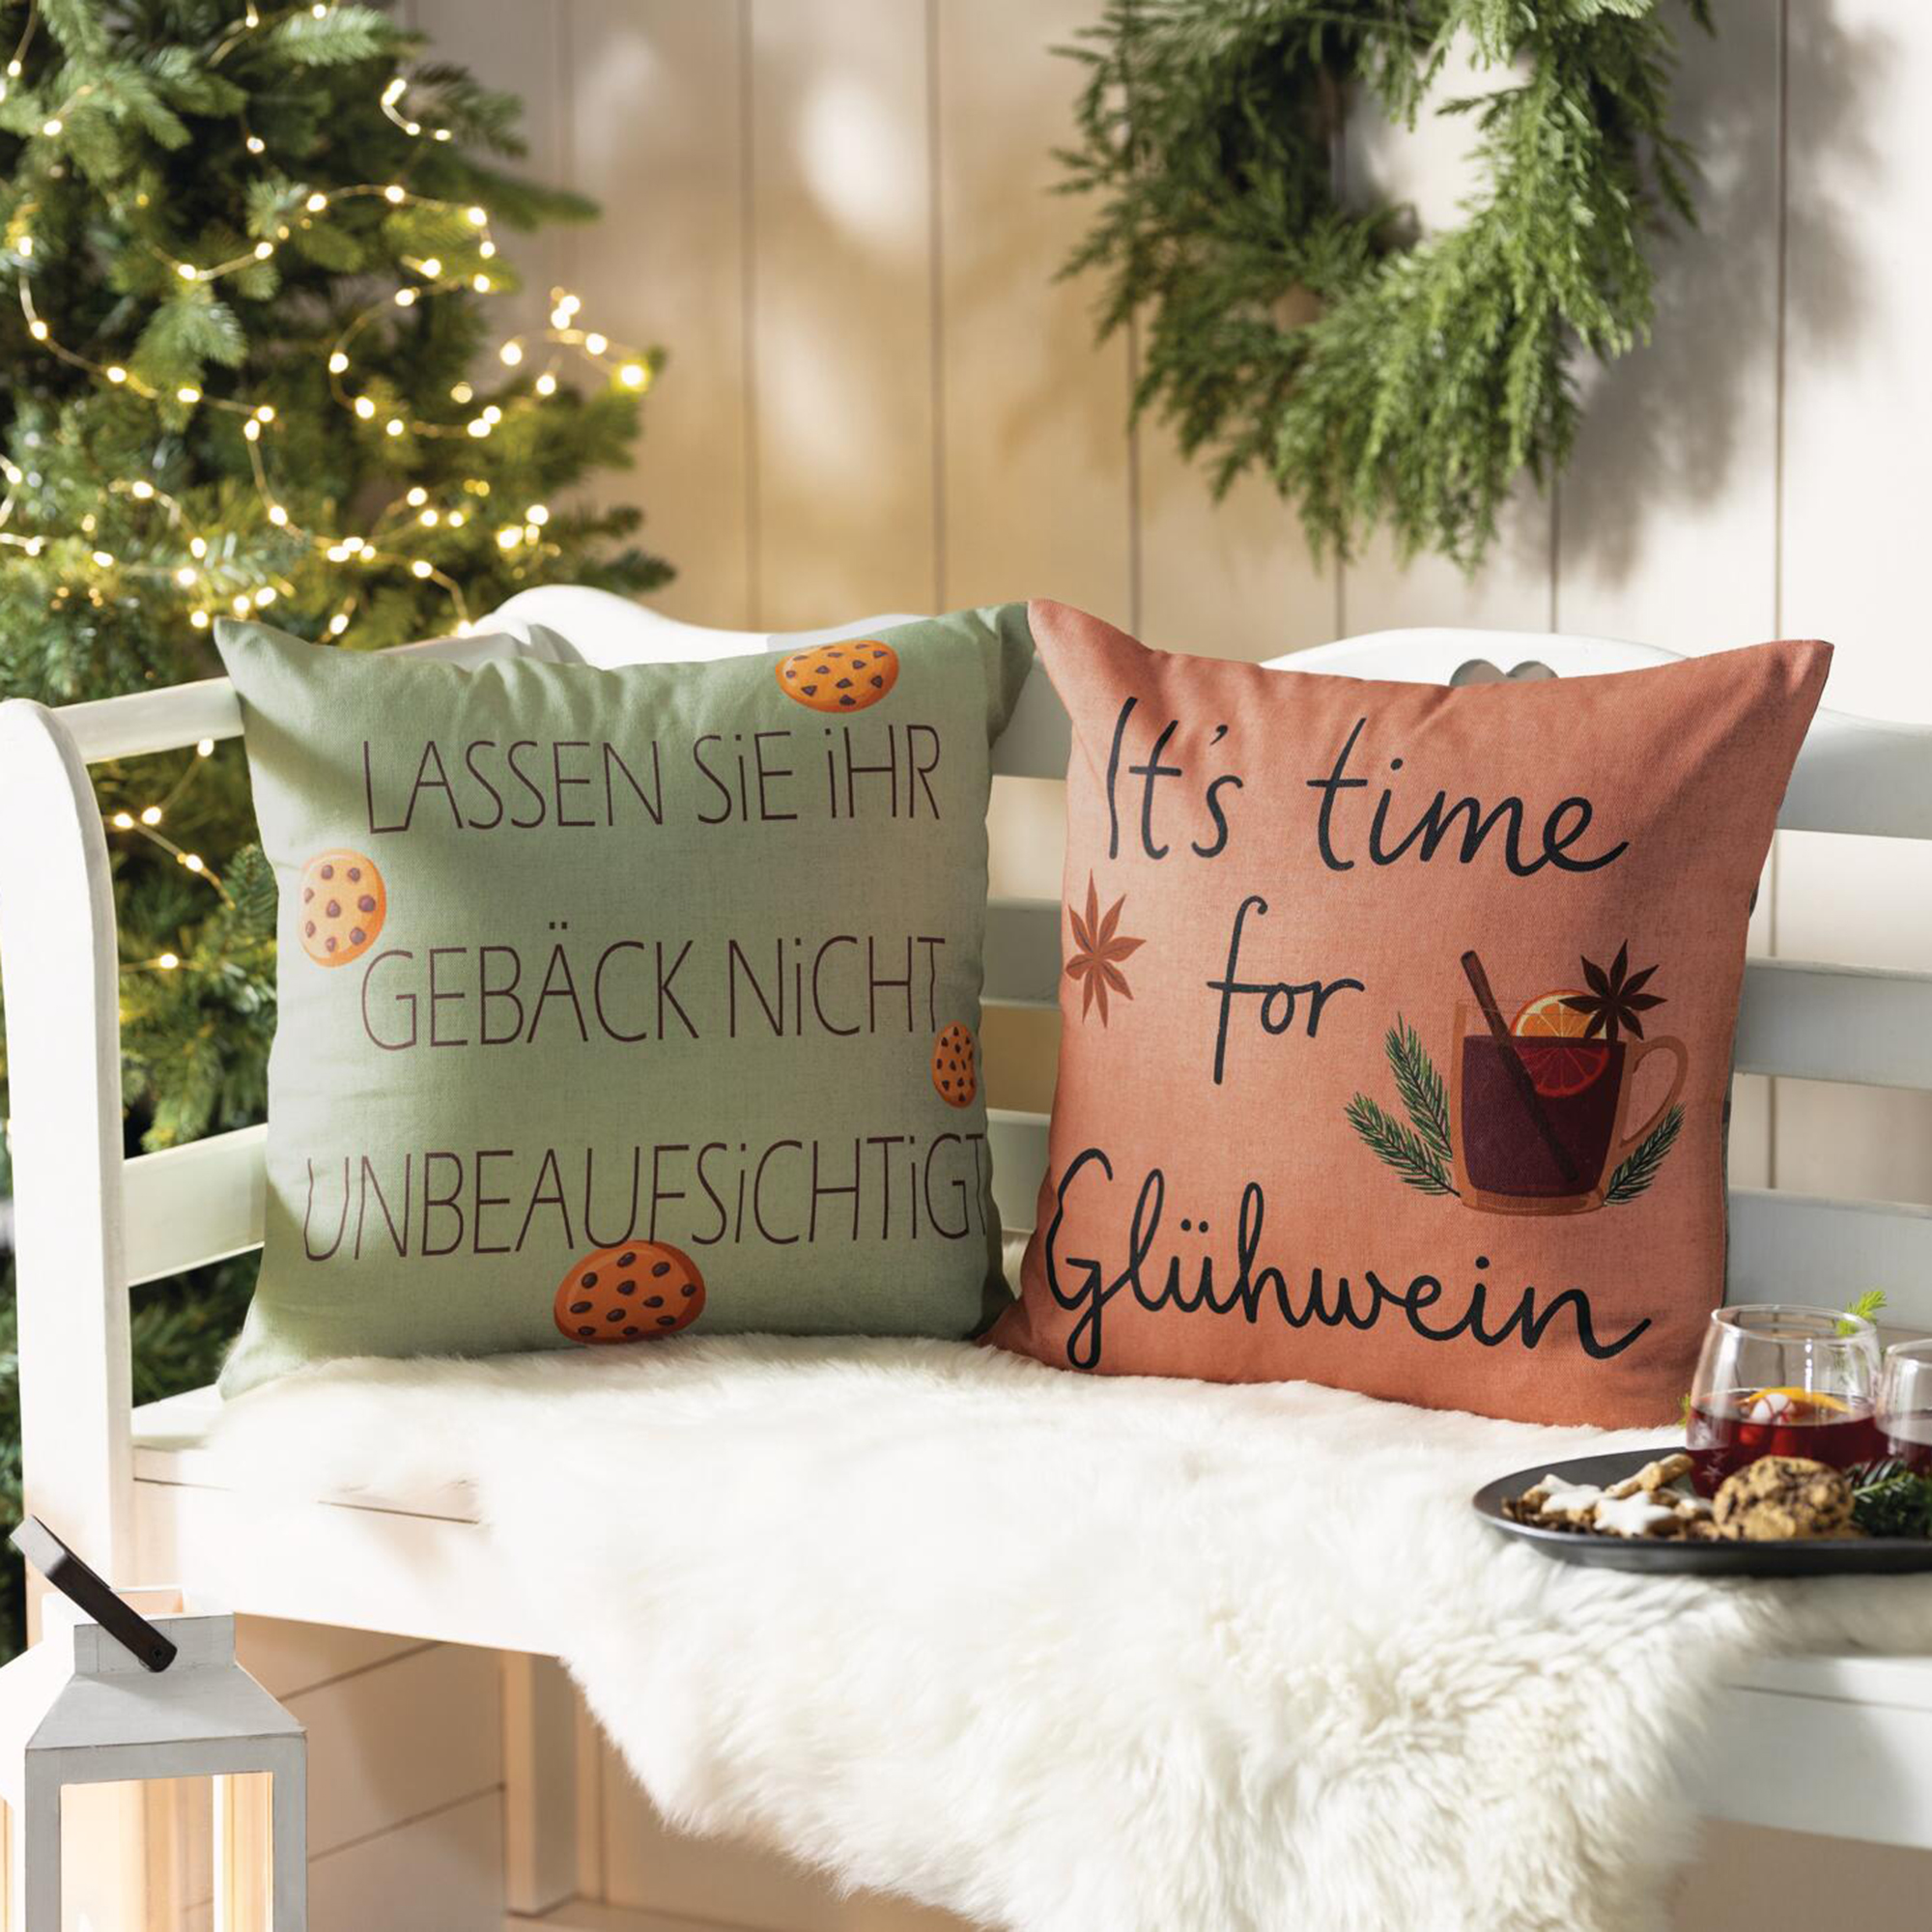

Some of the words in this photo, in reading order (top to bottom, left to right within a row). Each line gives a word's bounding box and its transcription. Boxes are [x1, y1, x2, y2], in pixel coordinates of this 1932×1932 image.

[363, 740, 664, 835] LASSEN
[1106, 696, 1244, 861] It's
[1306, 718, 1630, 876] time
[361, 922, 700, 1051] GEBÄCK
[1207, 895, 1365, 1085] for
[1044, 1148, 1651, 1370] Glühwein
